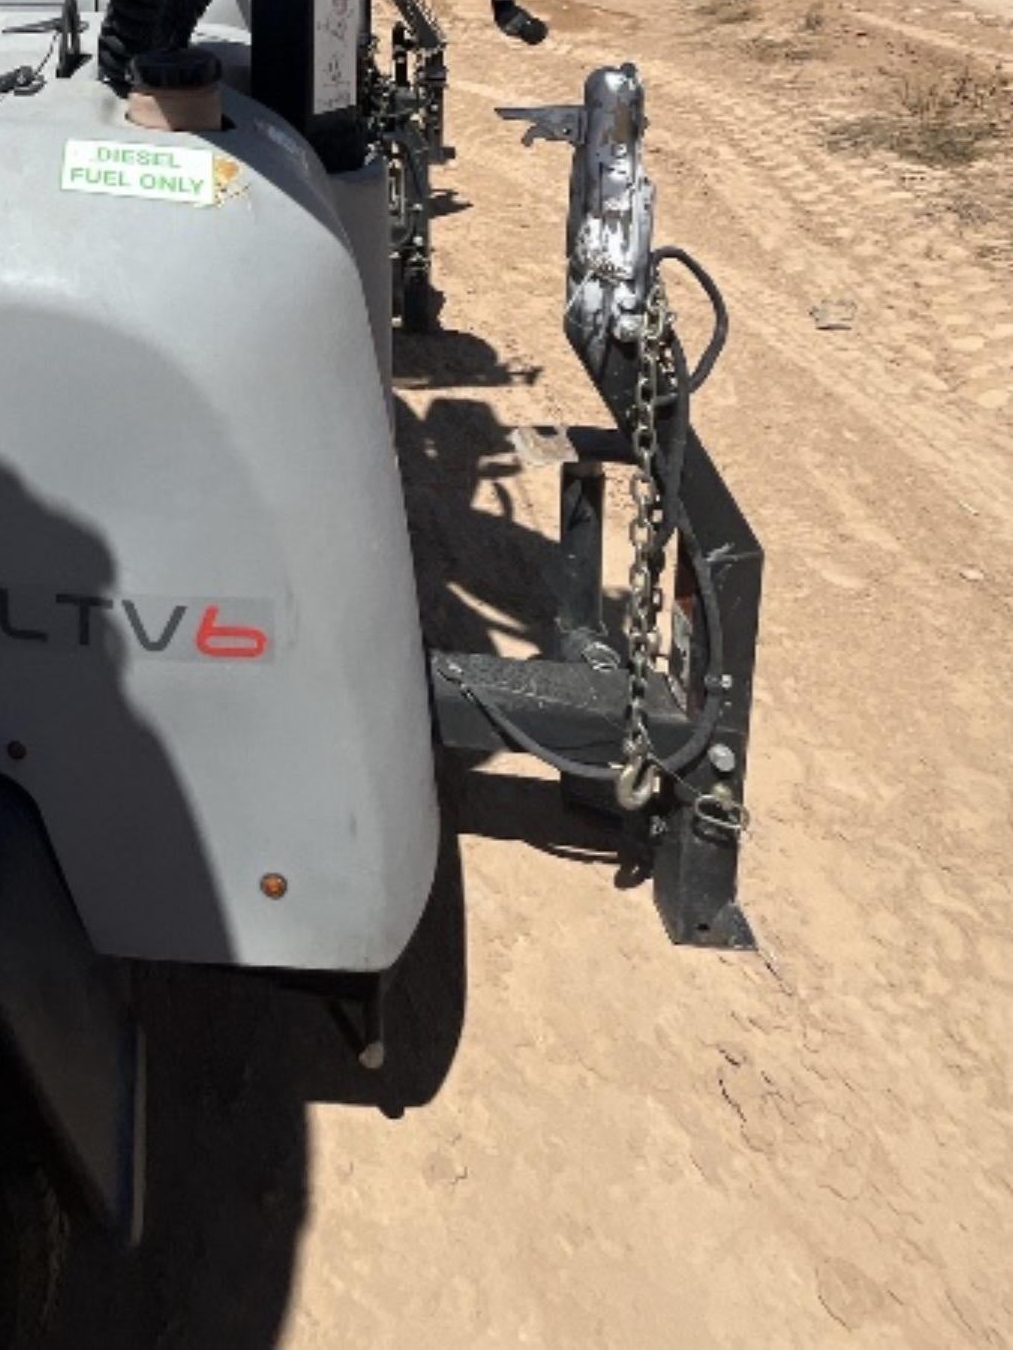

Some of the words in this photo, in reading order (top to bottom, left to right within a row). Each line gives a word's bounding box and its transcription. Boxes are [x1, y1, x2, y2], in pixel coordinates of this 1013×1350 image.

[96, 146, 181, 169] DIESEL
[69, 167, 130, 188] FUEL
[138, 173, 205, 196] ONLY
